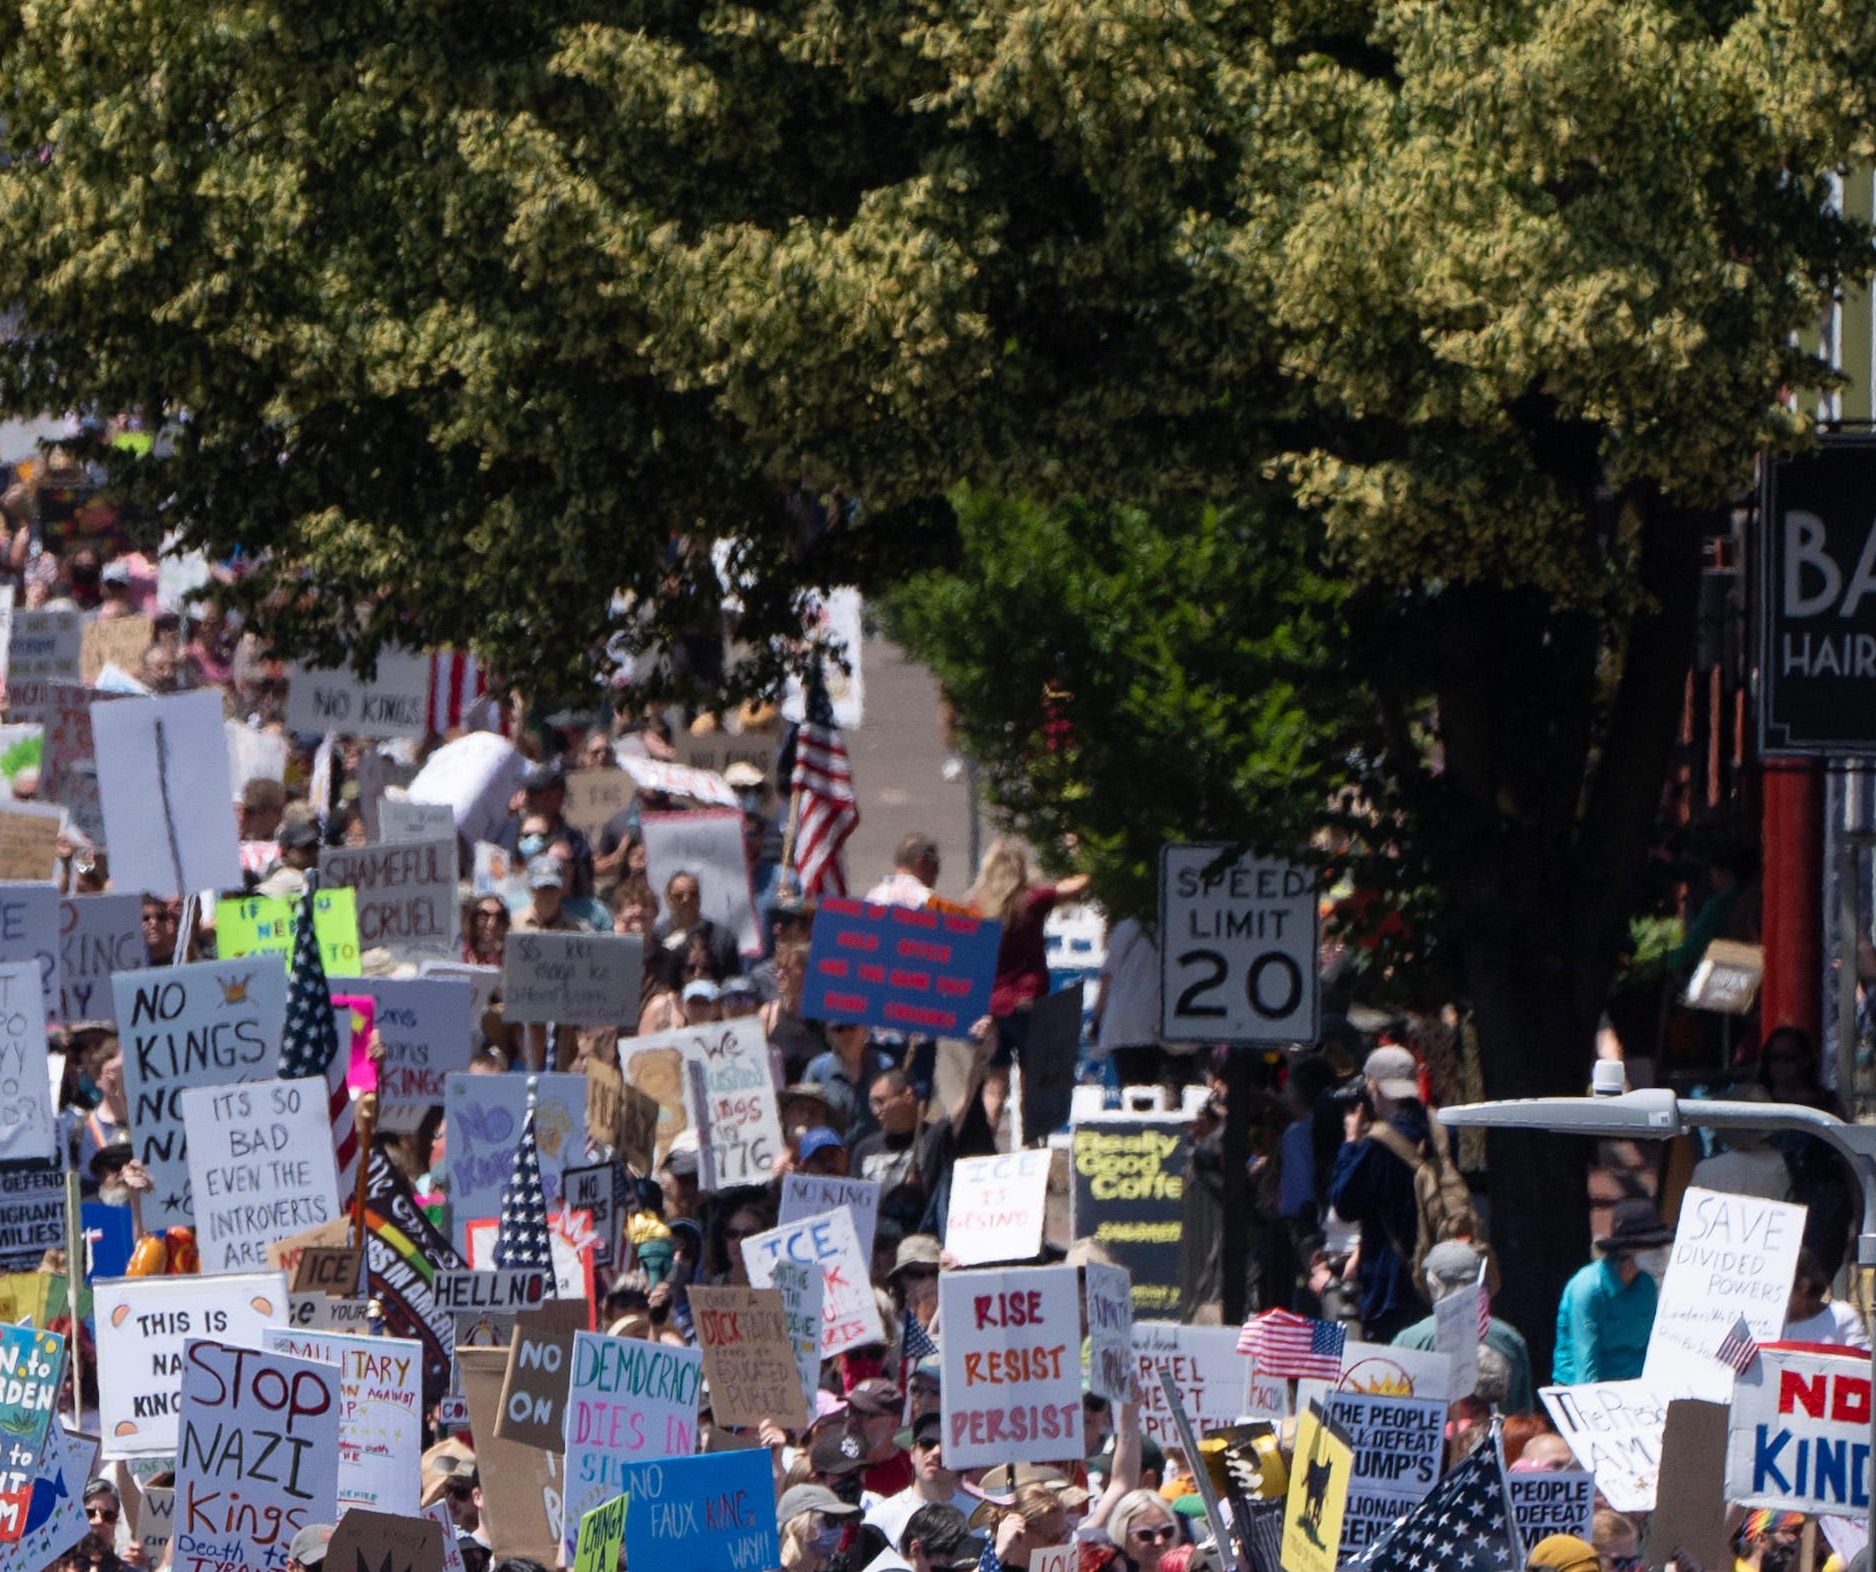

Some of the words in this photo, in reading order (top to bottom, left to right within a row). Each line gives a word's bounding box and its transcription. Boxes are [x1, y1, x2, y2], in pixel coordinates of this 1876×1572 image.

[314, 693, 351, 720] NO
[360, 695, 424, 724] KINGS
[326, 849, 452, 890] SHAMEFUL
[1176, 867, 1307, 897] SPEED
[360, 902, 446, 939] CRUEL
[1189, 909, 1290, 938] LIMIT
[1174, 949, 1303, 1019] 20
[131, 983, 186, 1027] NO
[135, 1022, 266, 1081] KINGS
[272, 1090, 301, 1114] SO
[230, 1123, 288, 1157] BAD
[206, 1167, 264, 1196] EVEN
[268, 1161, 311, 1189] THE
[210, 1196, 328, 1242] INTROVERTS
[1691, 1198, 1787, 1252] SAVE
[224, 1243, 268, 1269] ARE
[1675, 1243, 1766, 1273] DIVIDED
[1707, 1273, 1787, 1303] POWERS
[138, 1312, 193, 1336] THIS
[205, 1310, 227, 1332] IS
[974, 1290, 1044, 1331] RISE
[28, 1360, 51, 1377] to
[574, 1338, 701, 1407] DEMOCRACY
[965, 1345, 1067, 1385] RESIST
[577, 1402, 645, 1450] DIES
[666, 1414, 694, 1453] IN
[951, 1403, 1080, 1448] PERSIST
[183, 1421, 313, 1500] NAZI
[632, 1464, 663, 1499] NO
[651, 1505, 698, 1539] FAUX
[706, 1490, 755, 1529] KING
[179, 1535, 243, 1561] Death
